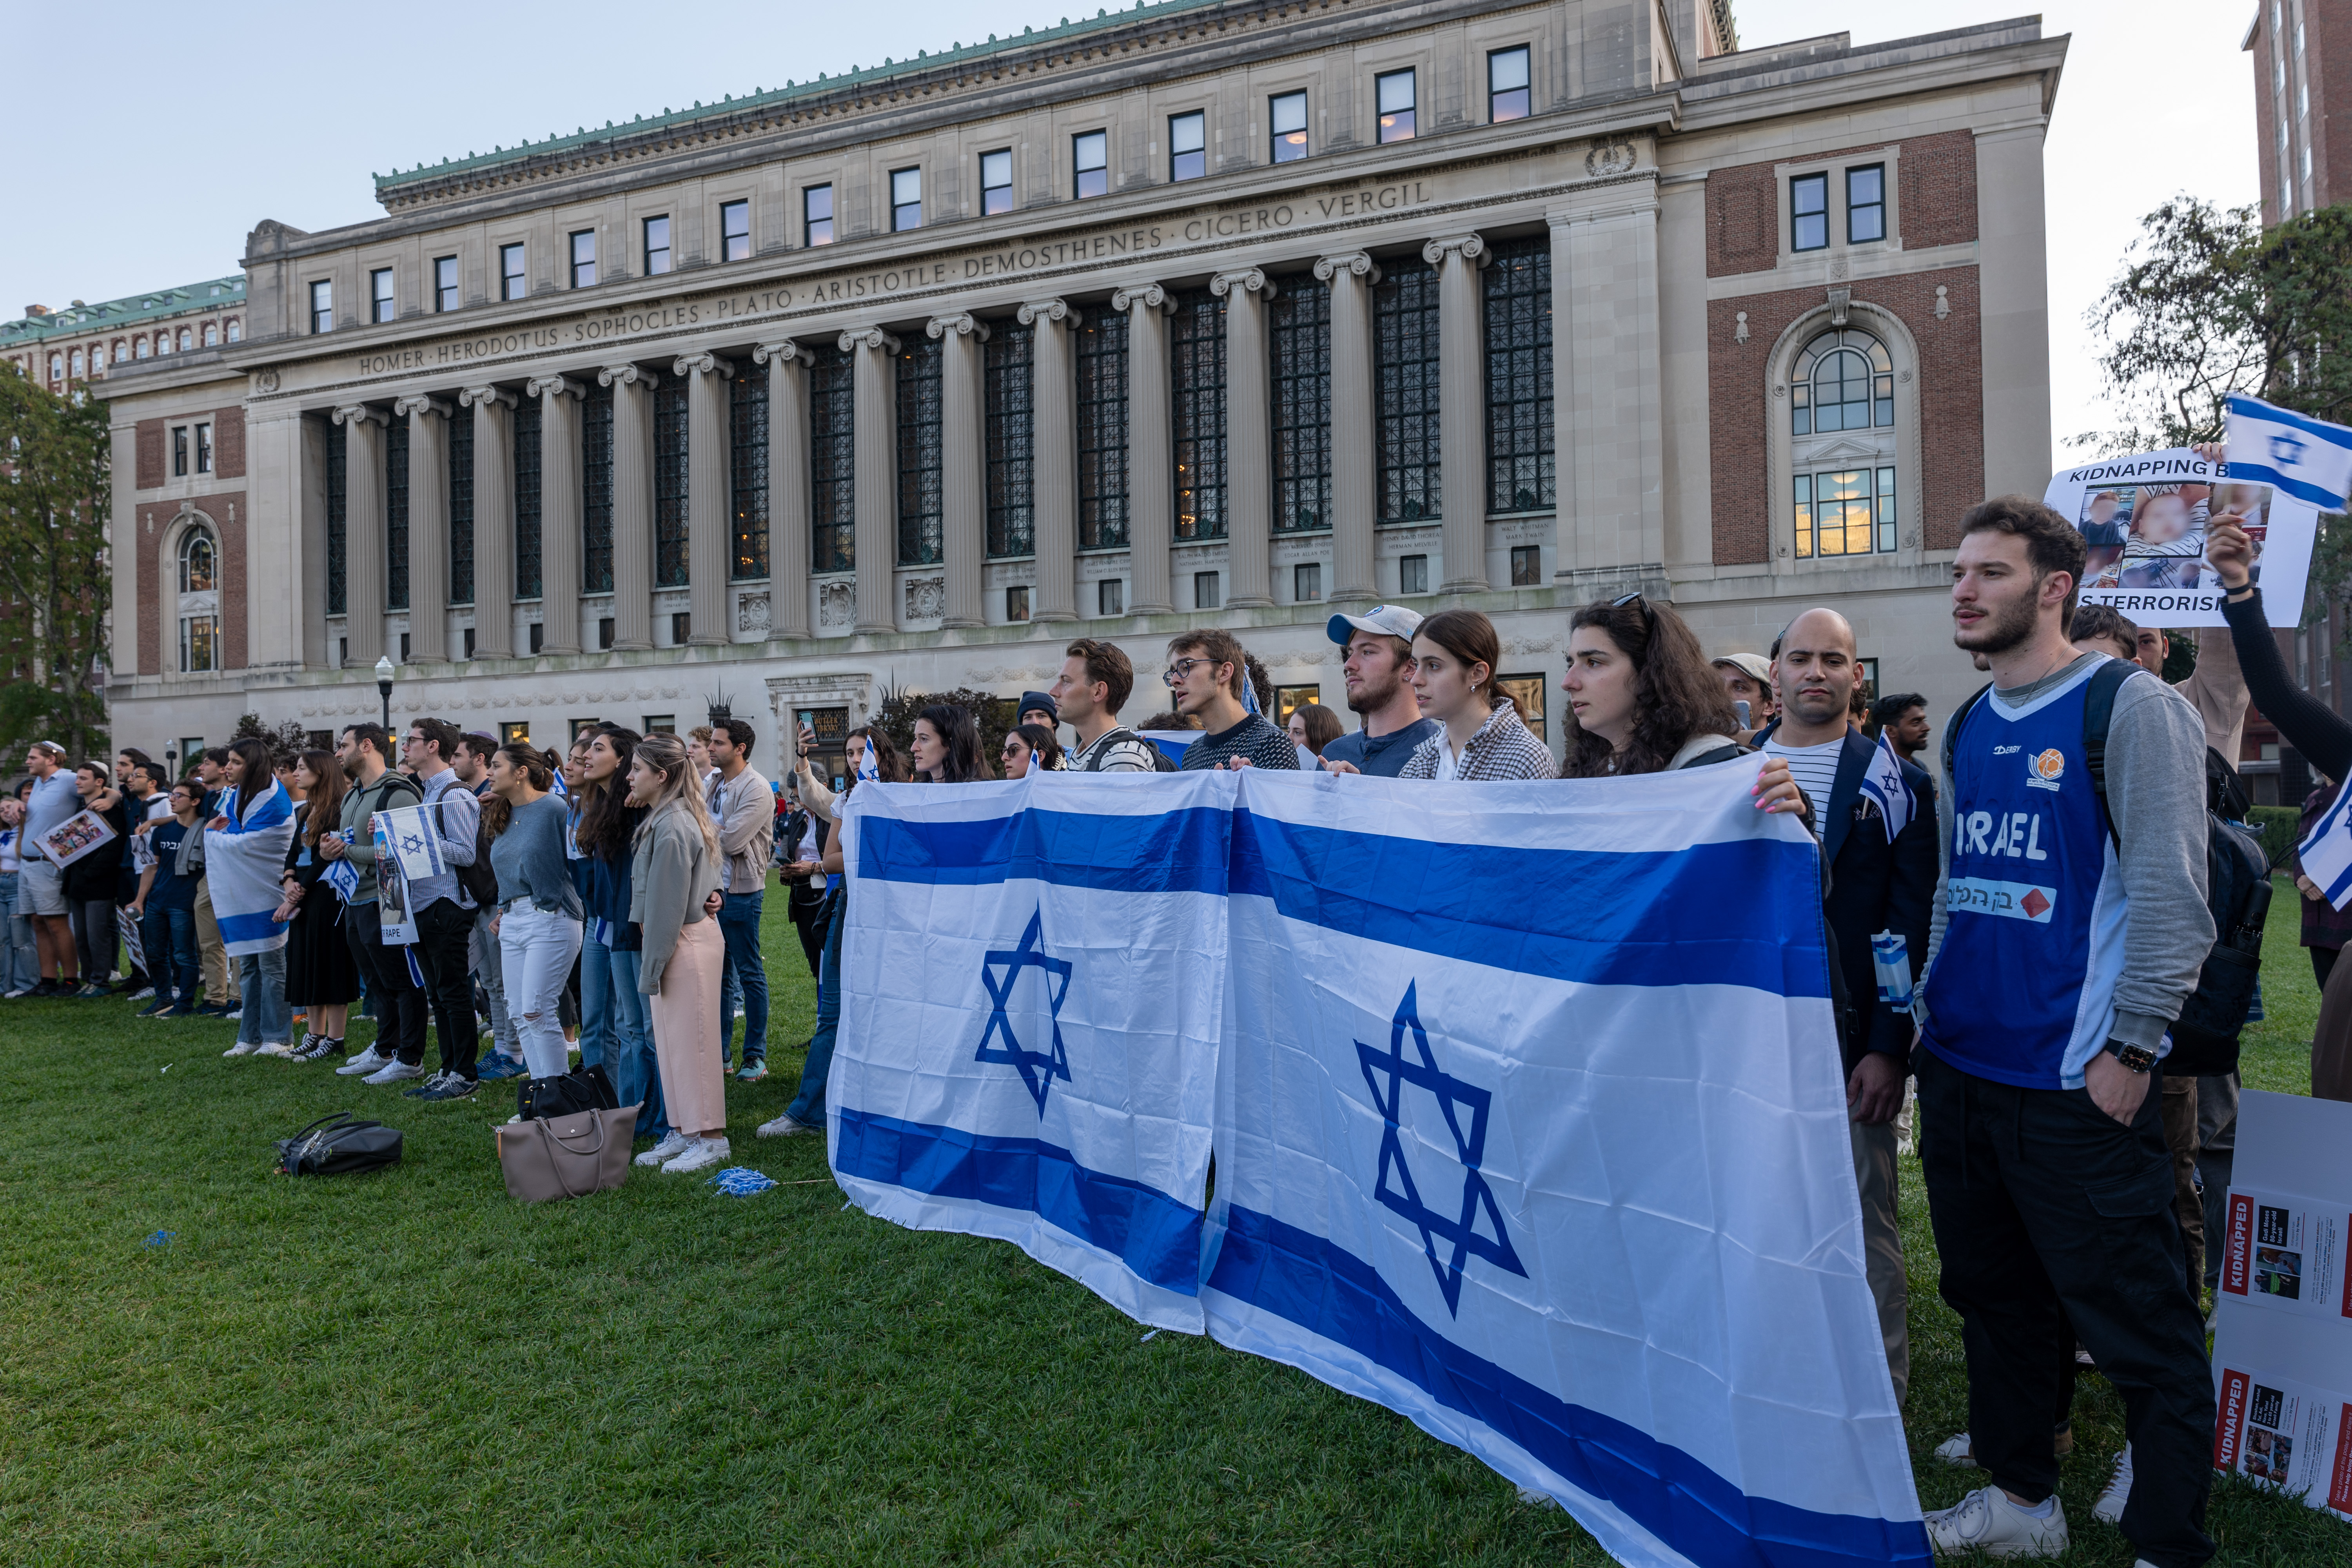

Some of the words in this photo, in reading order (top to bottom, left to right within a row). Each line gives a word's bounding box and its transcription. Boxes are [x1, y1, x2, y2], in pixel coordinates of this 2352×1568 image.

[360, 351, 425, 375] HOMER
[438, 328, 557, 363] HERODOTUS
[575, 305, 698, 341] SOPHOCLES
[718, 290, 791, 319] PLATO
[813, 264, 945, 303] ARISTOTLE
[965, 227, 1161, 278] DEMOSTHENES
[1185, 206, 1293, 241] CICERO
[1317, 182, 1429, 219] VERGIL
[2069, 459, 2207, 482] KIDNAPPING
[2100, 595, 2222, 611] TERRORIS
[386, 928, 401, 938] RAPE
[2231, 1201, 2247, 1287] KIDNAPPED
[2220, 1378, 2242, 1465] KIDNAPPED
